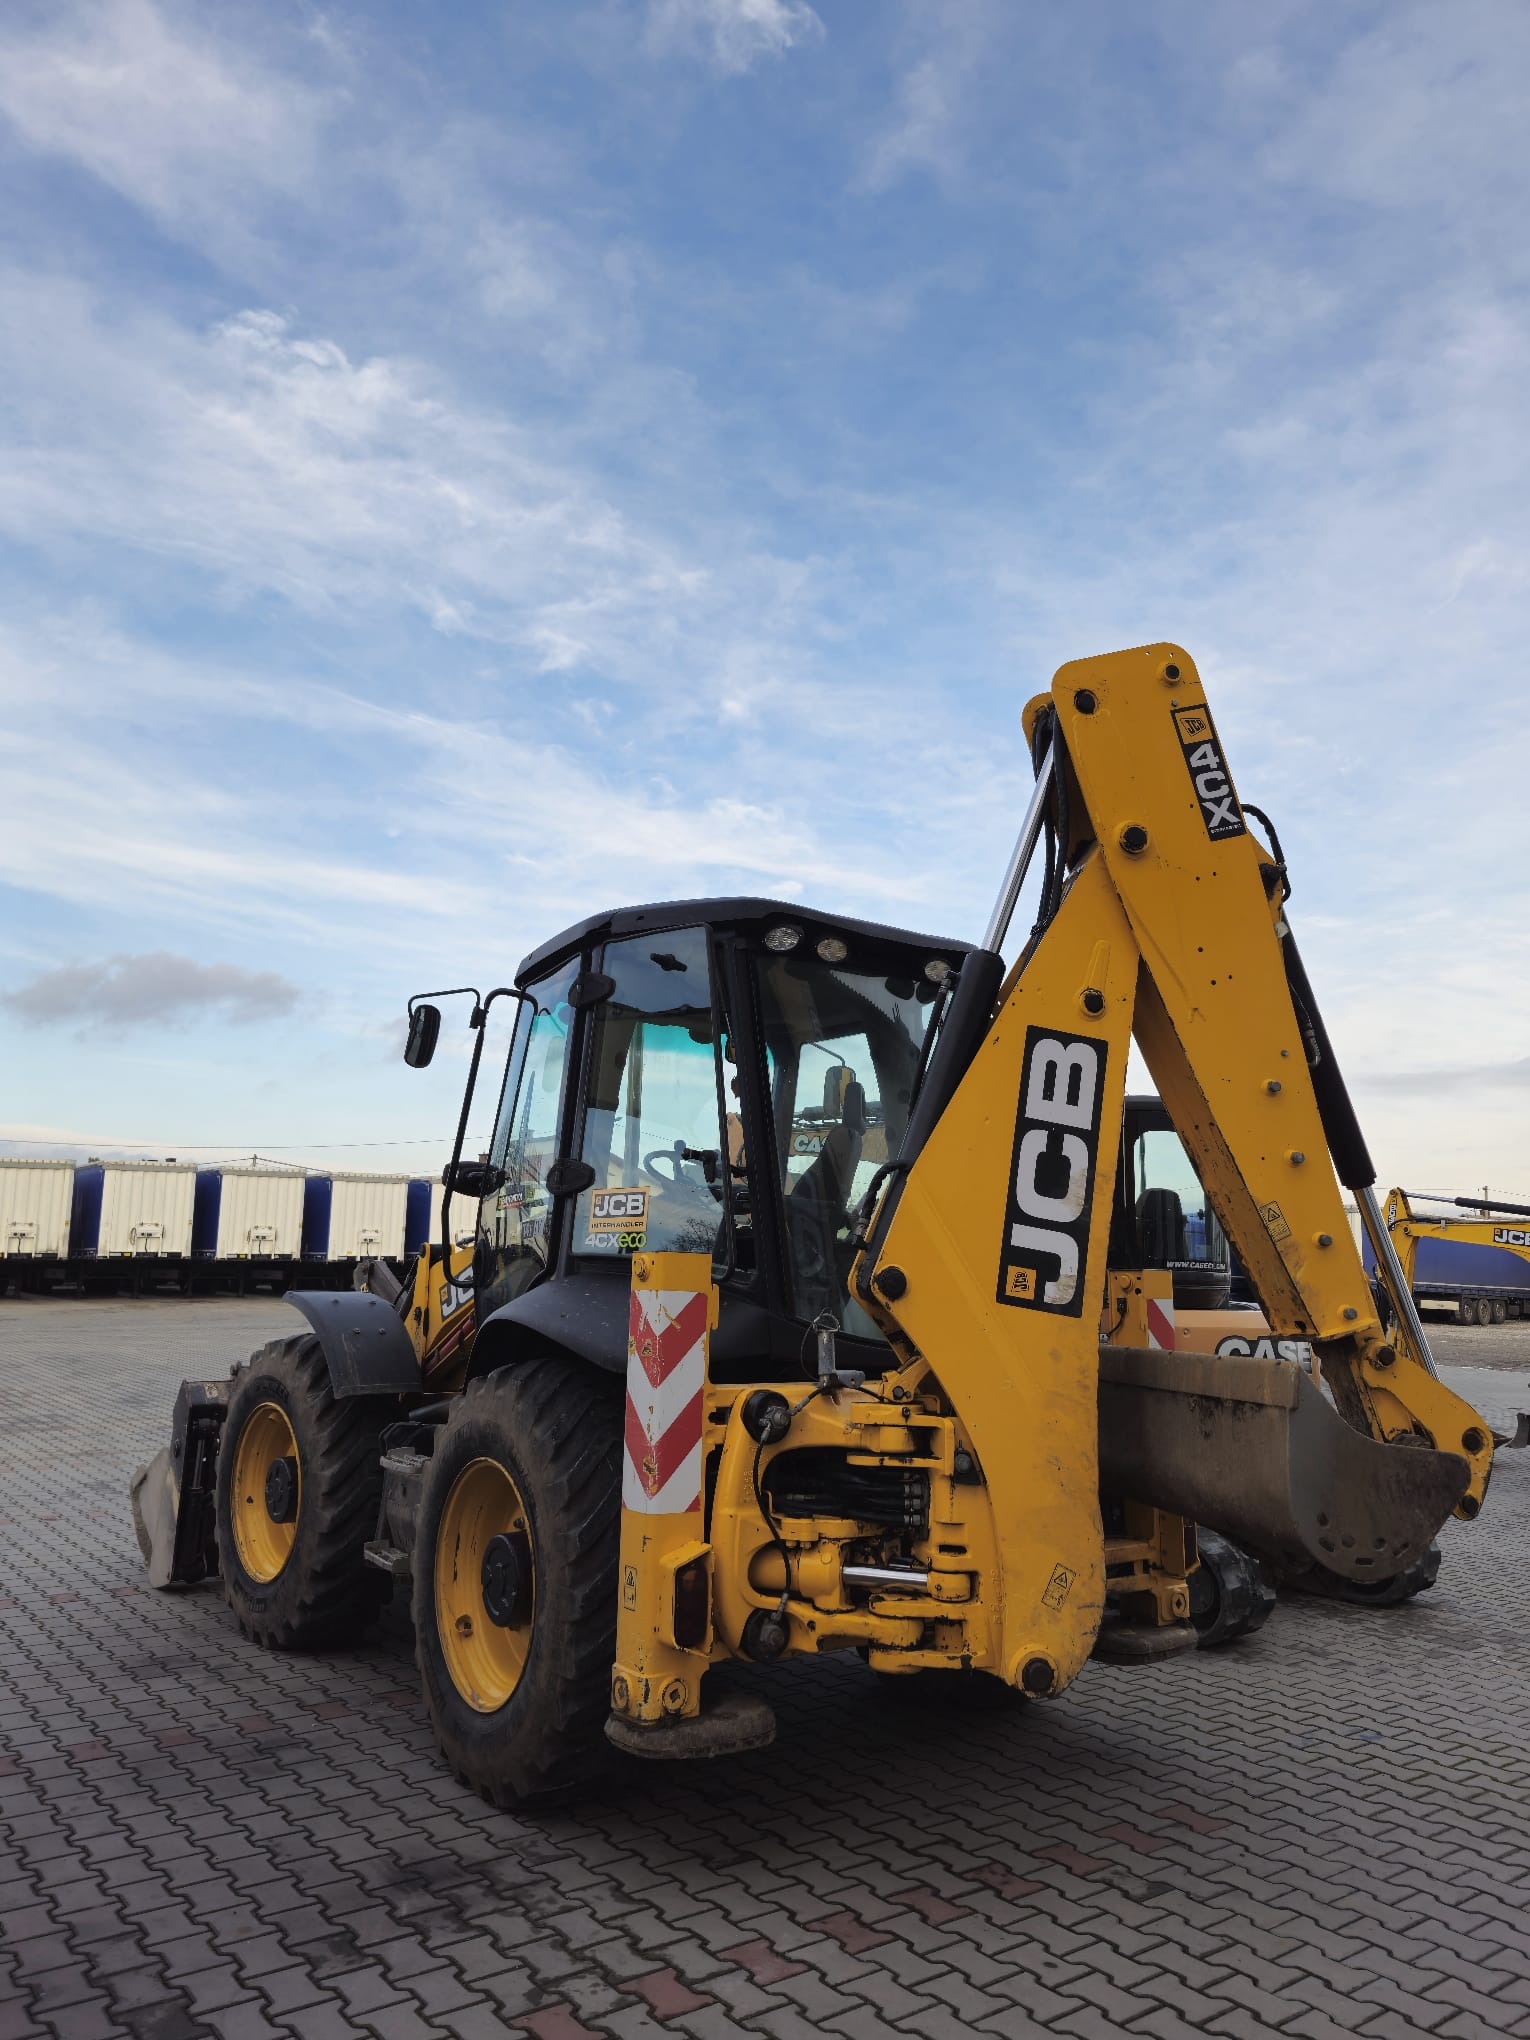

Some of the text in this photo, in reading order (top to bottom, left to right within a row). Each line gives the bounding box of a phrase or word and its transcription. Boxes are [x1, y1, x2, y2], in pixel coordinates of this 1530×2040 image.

[1183, 718, 1206, 736] JCB
[1189, 742, 1241, 829] 4CX
[1011, 1038, 1098, 1305] JCB
[595, 1195, 644, 1216] JCB
[591, 1221, 644, 1229] INTERHANDLER
[441, 1265, 475, 1317] JC
[1012, 1271, 1029, 1291] JCB
